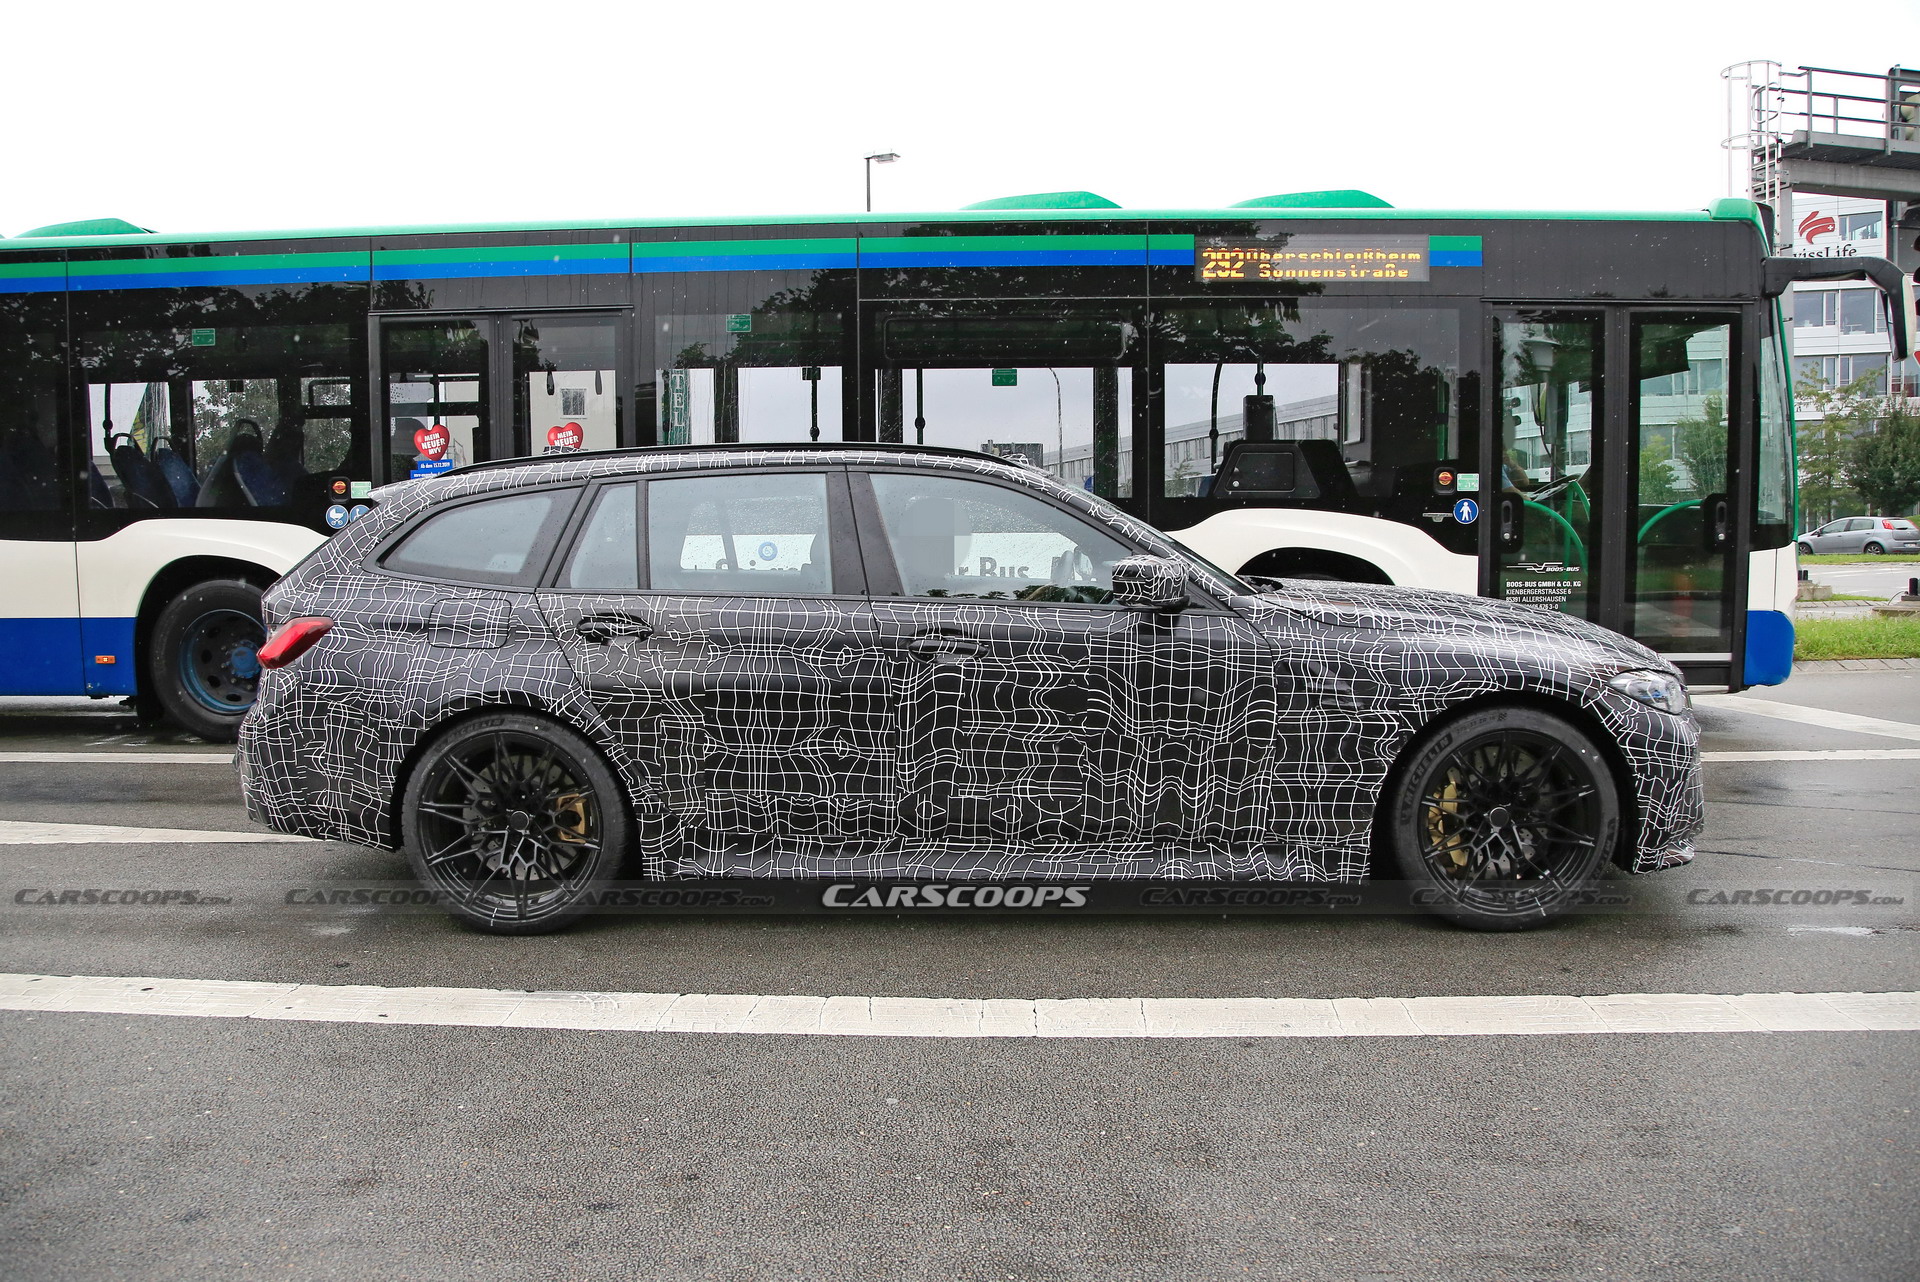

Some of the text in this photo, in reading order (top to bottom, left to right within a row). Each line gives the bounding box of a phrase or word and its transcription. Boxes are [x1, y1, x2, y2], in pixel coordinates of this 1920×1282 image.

[1202, 247, 1245, 278] 292
[1259, 262, 1410, 279] Sonnenstraße
[424, 432, 440, 442] MEIN
[554, 435, 579, 446] NEUER
[556, 430, 573, 439] MEIN
[421, 437, 446, 450] NEUER
[428, 446, 442, 455] MVV
[979, 556, 1030, 578] Bus
[1521, 595, 1567, 603] ALLERSHAUSEN
[1404, 735, 1450, 805] MICHELIN
